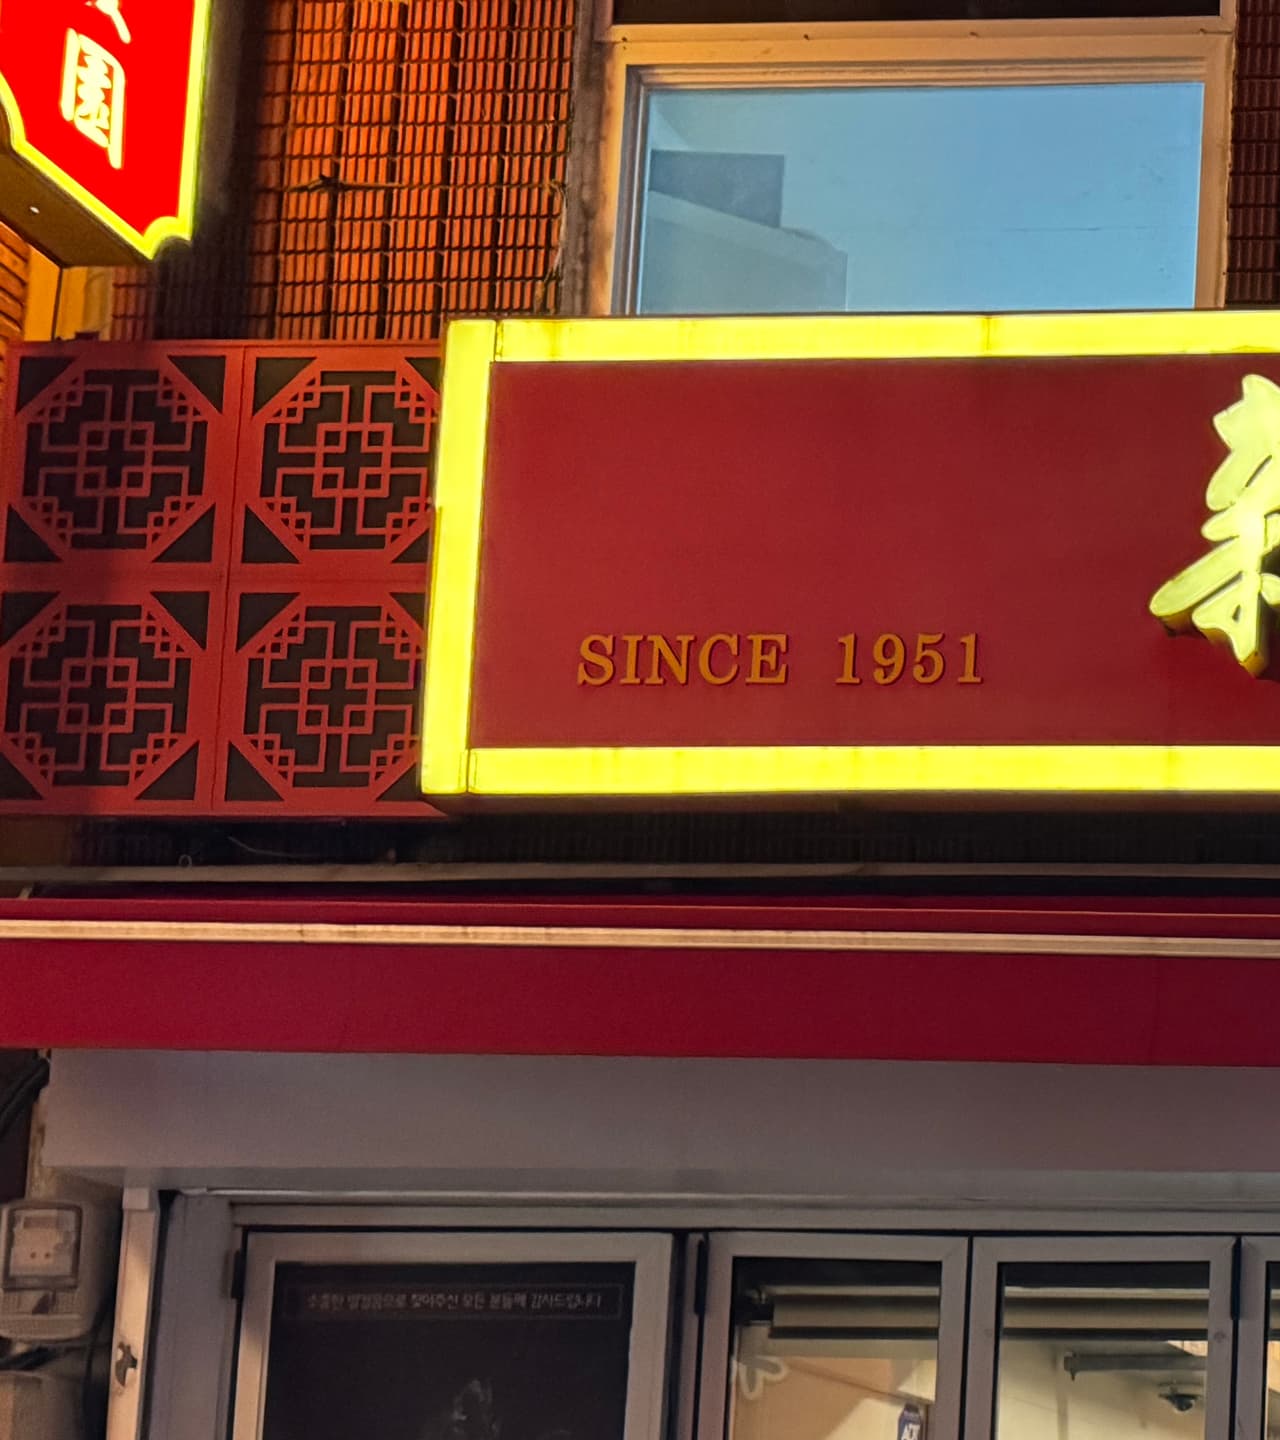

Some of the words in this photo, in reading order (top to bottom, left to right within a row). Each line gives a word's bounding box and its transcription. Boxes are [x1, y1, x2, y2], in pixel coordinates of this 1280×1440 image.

[60, 0, 131, 170] 園
[576, 633, 789, 687] SINCE
[834, 633, 983, 686] 1951
